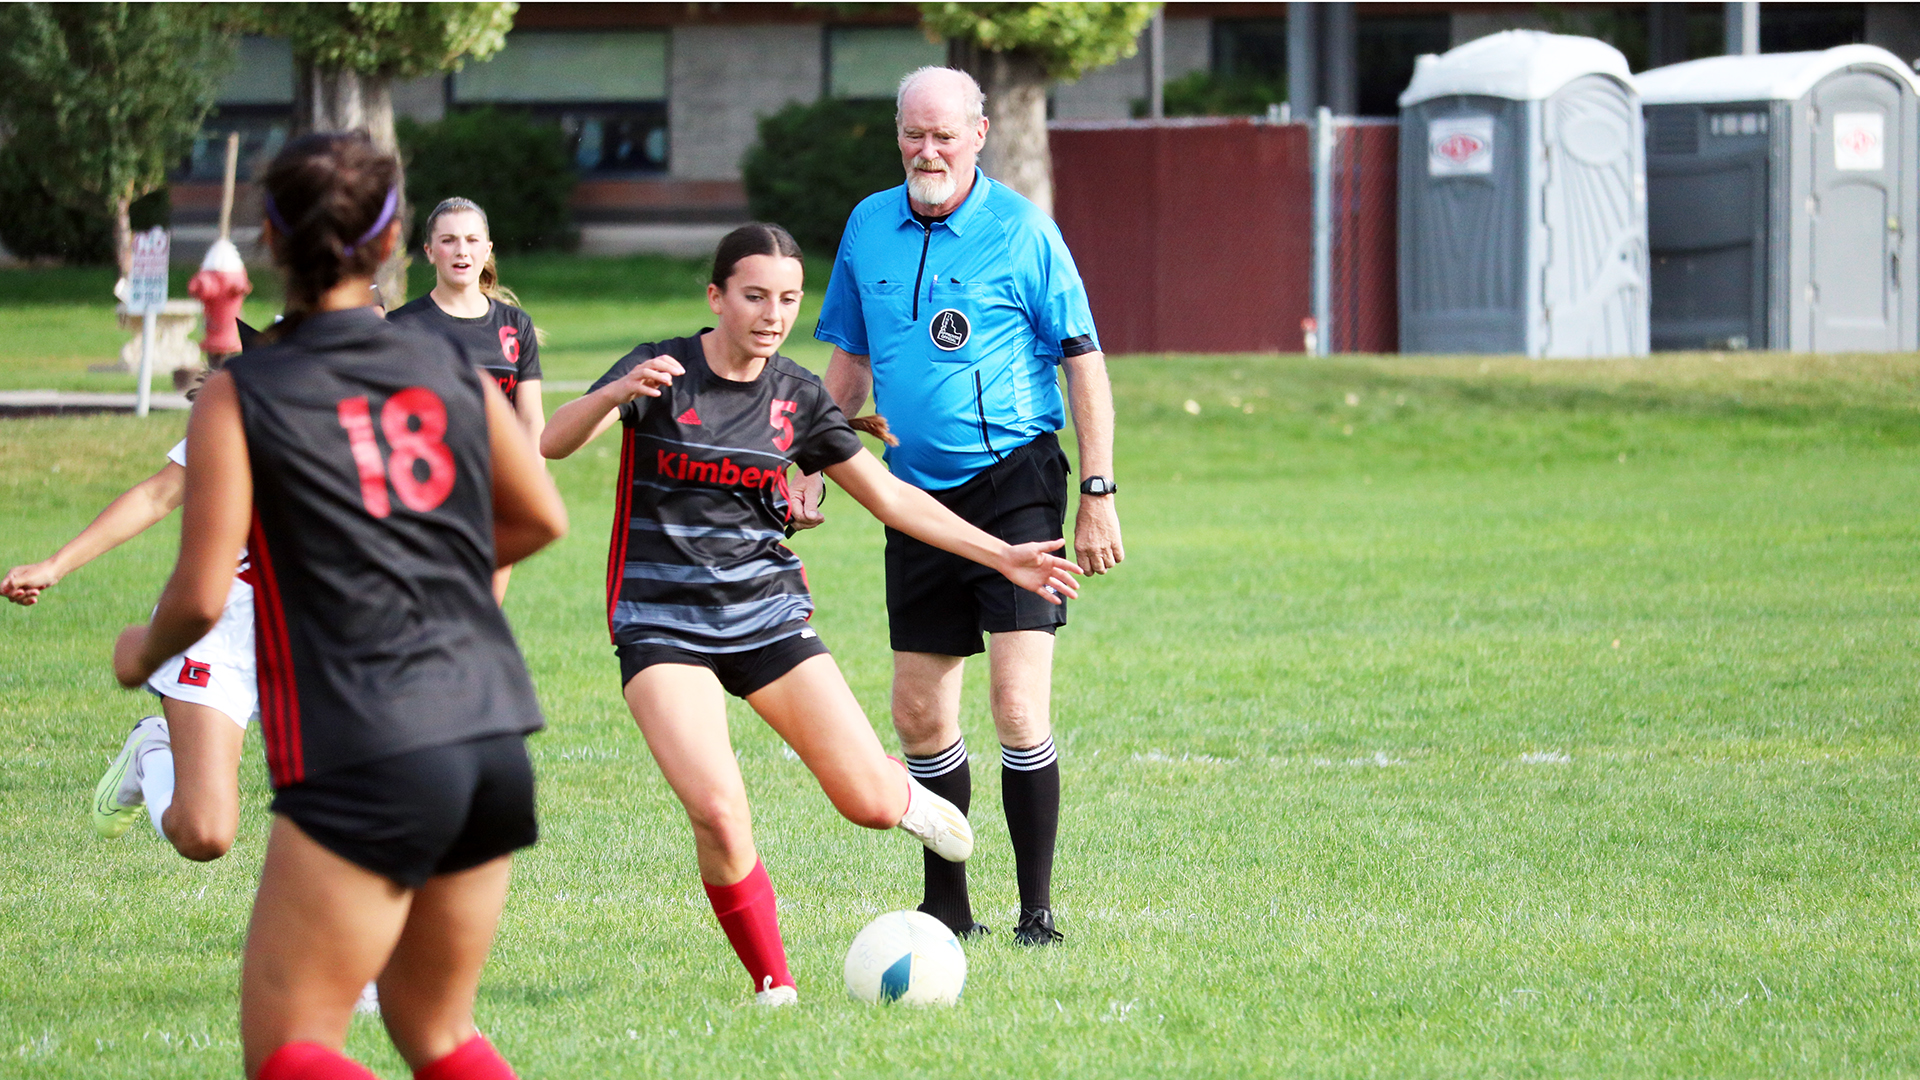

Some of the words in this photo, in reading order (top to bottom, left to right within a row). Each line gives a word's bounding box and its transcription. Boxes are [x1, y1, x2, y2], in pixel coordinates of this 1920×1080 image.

[498, 325, 520, 364] 6
[769, 398, 798, 452] 5
[336, 385, 457, 519] 18
[177, 655, 212, 688] G
